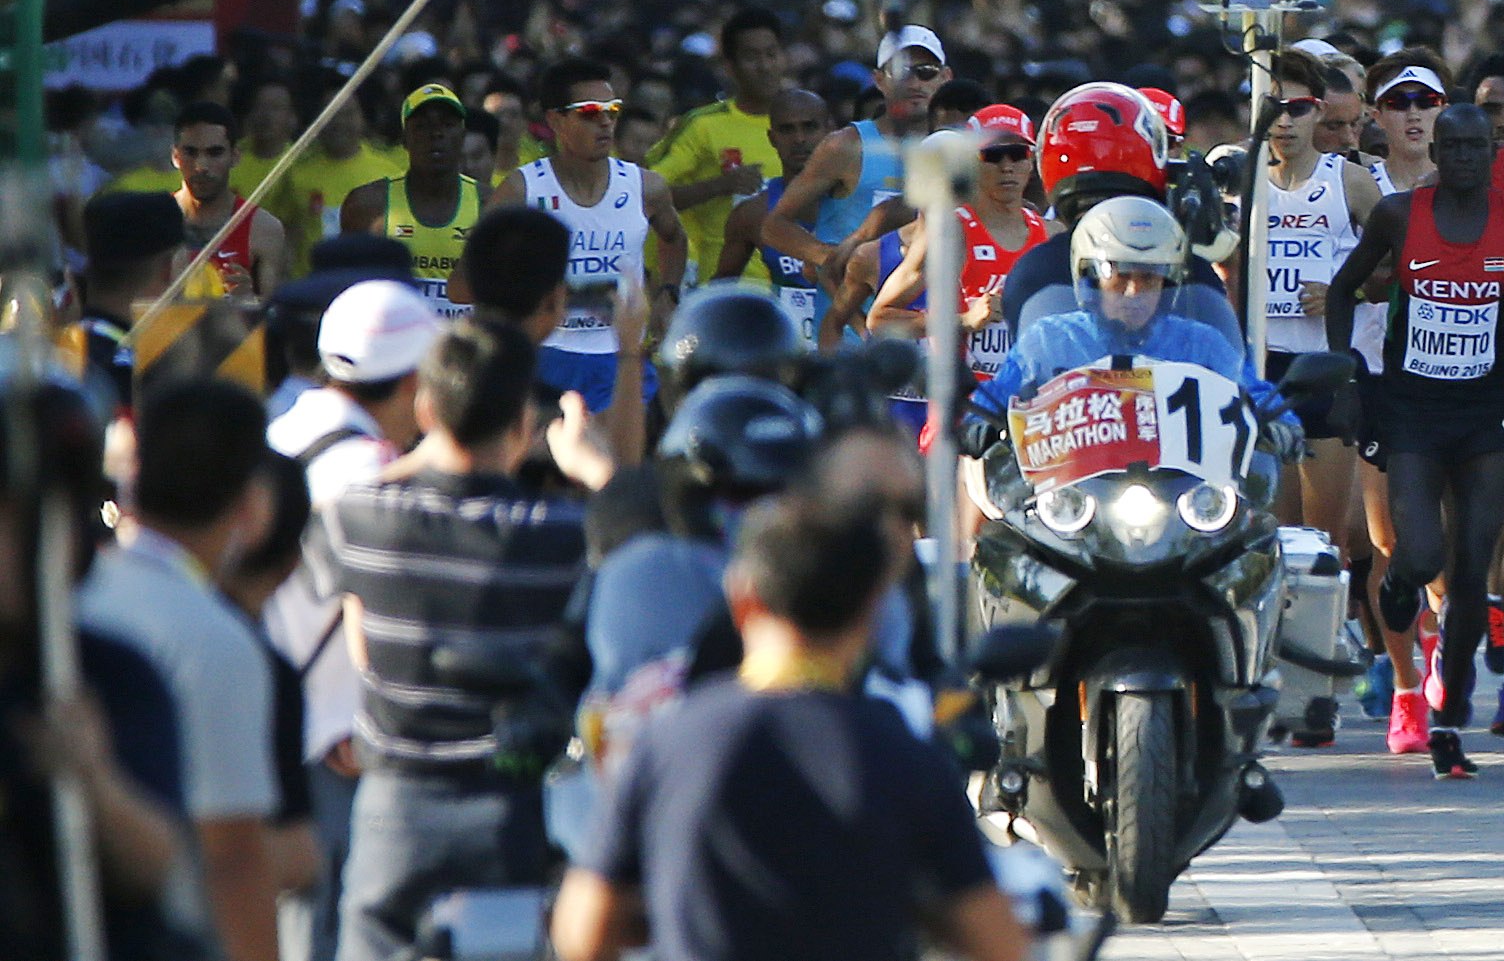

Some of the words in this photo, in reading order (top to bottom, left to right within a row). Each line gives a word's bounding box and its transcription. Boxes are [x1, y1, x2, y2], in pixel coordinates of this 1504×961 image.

[1267, 240, 1323, 258] TDK
[567, 254, 622, 275] TDK
[1413, 278, 1501, 299] KENYA
[1434, 305, 1491, 325] TDK
[971, 328, 1011, 353] FUJI
[1411, 326, 1490, 357] KIMETTO
[1409, 358, 1460, 377] BEIJING
[1461, 361, 1491, 377] 2015
[1023, 391, 1124, 436] 马拉松
[1166, 376, 1249, 481] 11
[1025, 422, 1127, 467] MARATHON
